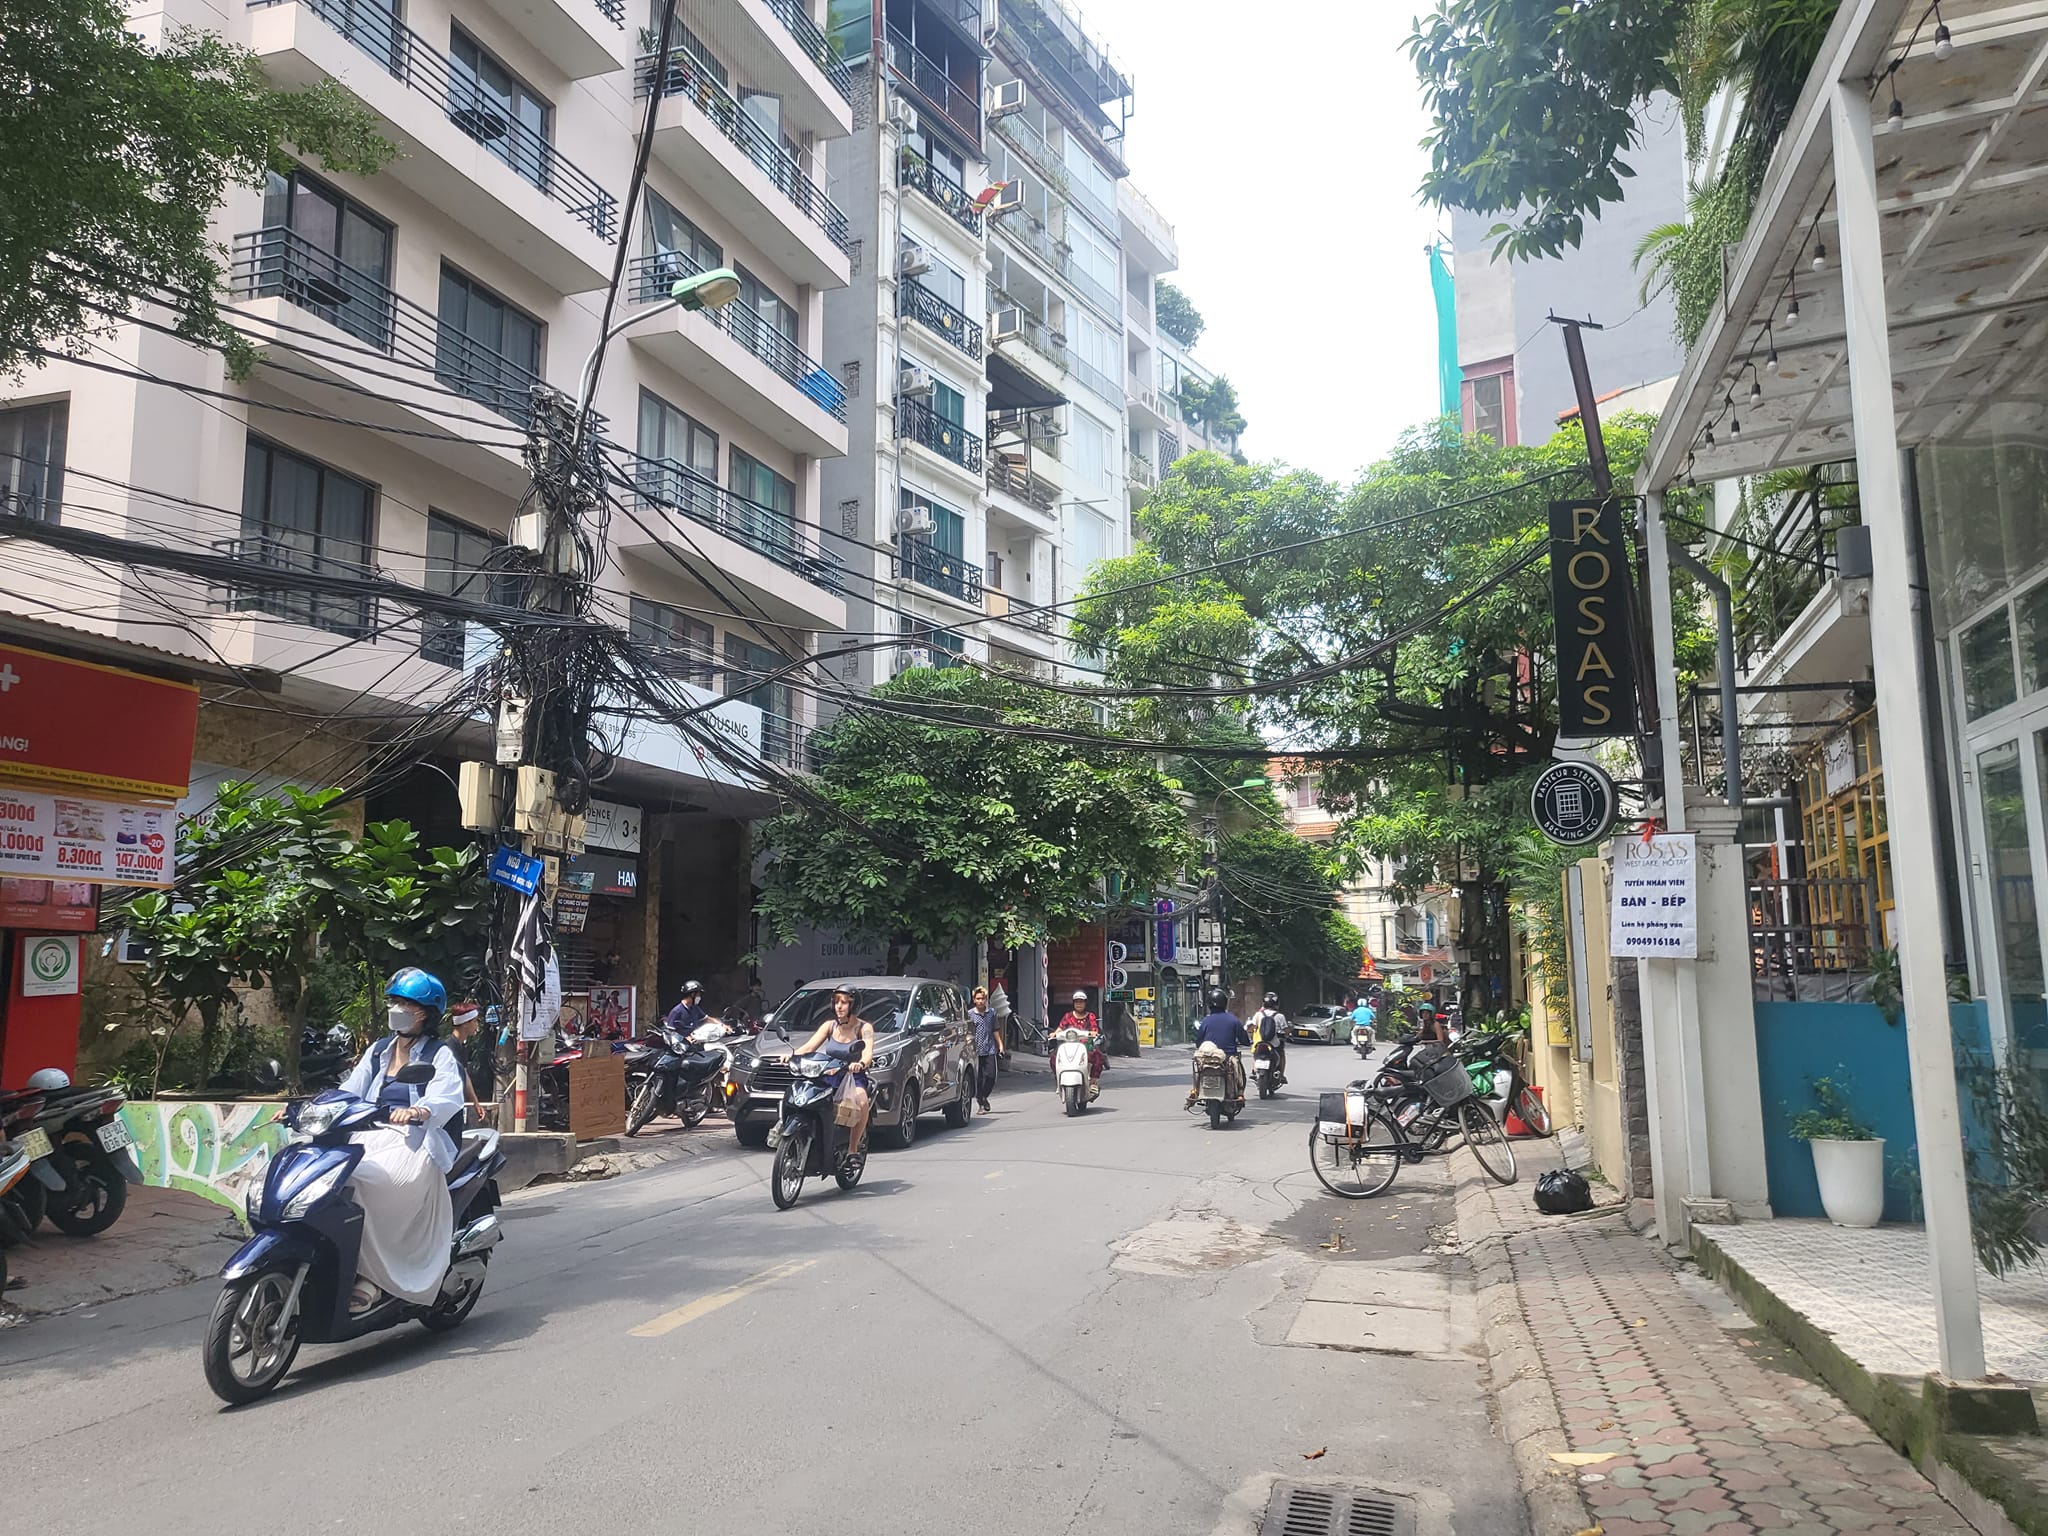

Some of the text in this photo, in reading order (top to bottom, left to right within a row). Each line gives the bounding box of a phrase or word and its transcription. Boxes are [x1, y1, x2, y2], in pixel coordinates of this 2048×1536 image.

[1567, 507, 1615, 726] ROSAS
[0, 736, 29, 752] NG!
[1536, 768, 1600, 798] PASTEUR STREET
[622, 820, 630, 838] 3
[1543, 818, 1599, 839] BREWING CO
[0, 832, 43, 852] .000đ
[1626, 841, 1688, 859] ROSAS
[58, 847, 102, 866] 8.300đ
[116, 853, 164, 870] 147.000đ
[1623, 860, 1641, 868] WEST
[1661, 892, 1686, 906] BẾP
[1626, 937, 1681, 946] 0904916184
